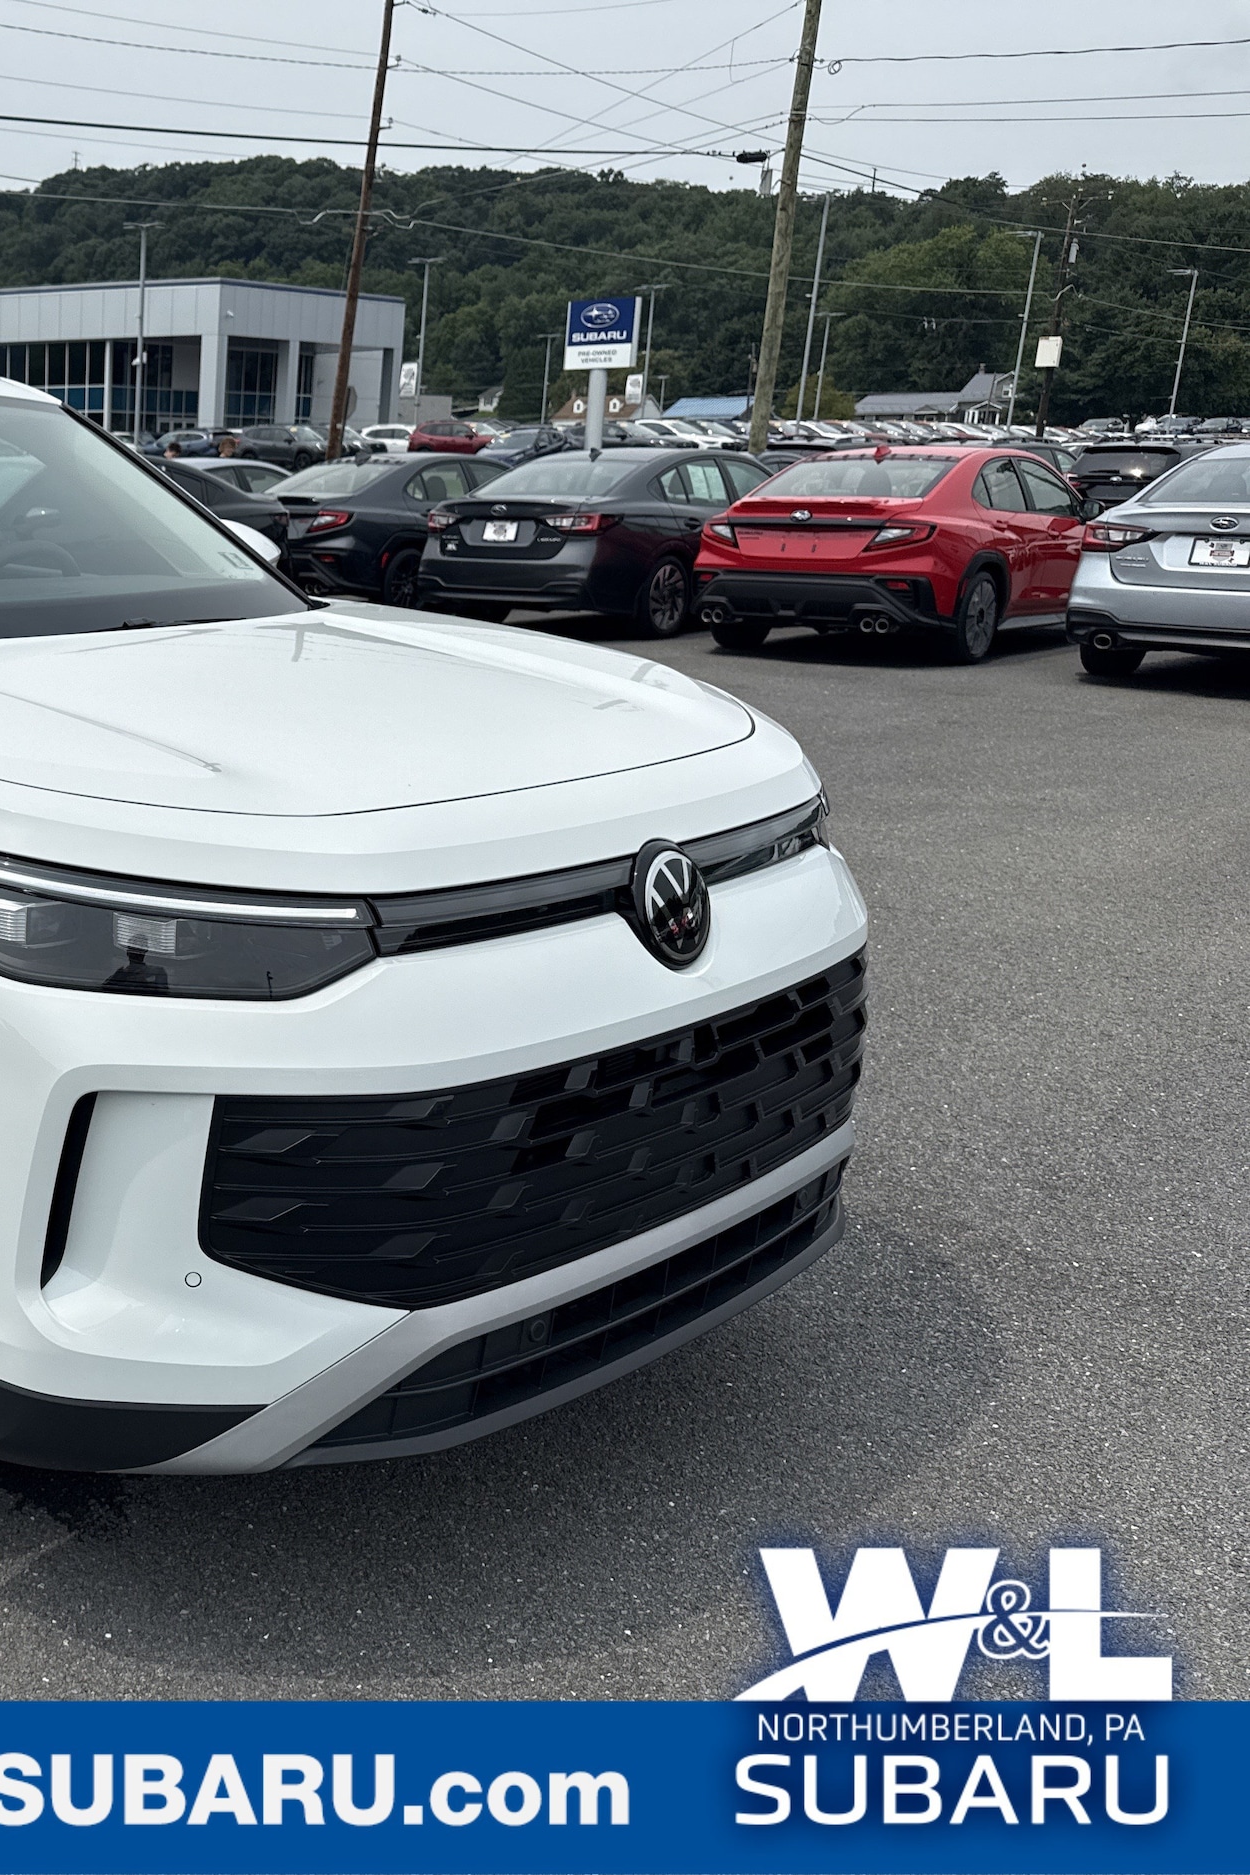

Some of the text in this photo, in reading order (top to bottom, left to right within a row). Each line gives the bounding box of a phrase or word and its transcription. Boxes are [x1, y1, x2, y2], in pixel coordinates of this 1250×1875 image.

[571, 330, 627, 343] SUBARU
[577, 349, 618, 357] PRE-OWNED
[580, 356, 613, 364] VEHICLES
